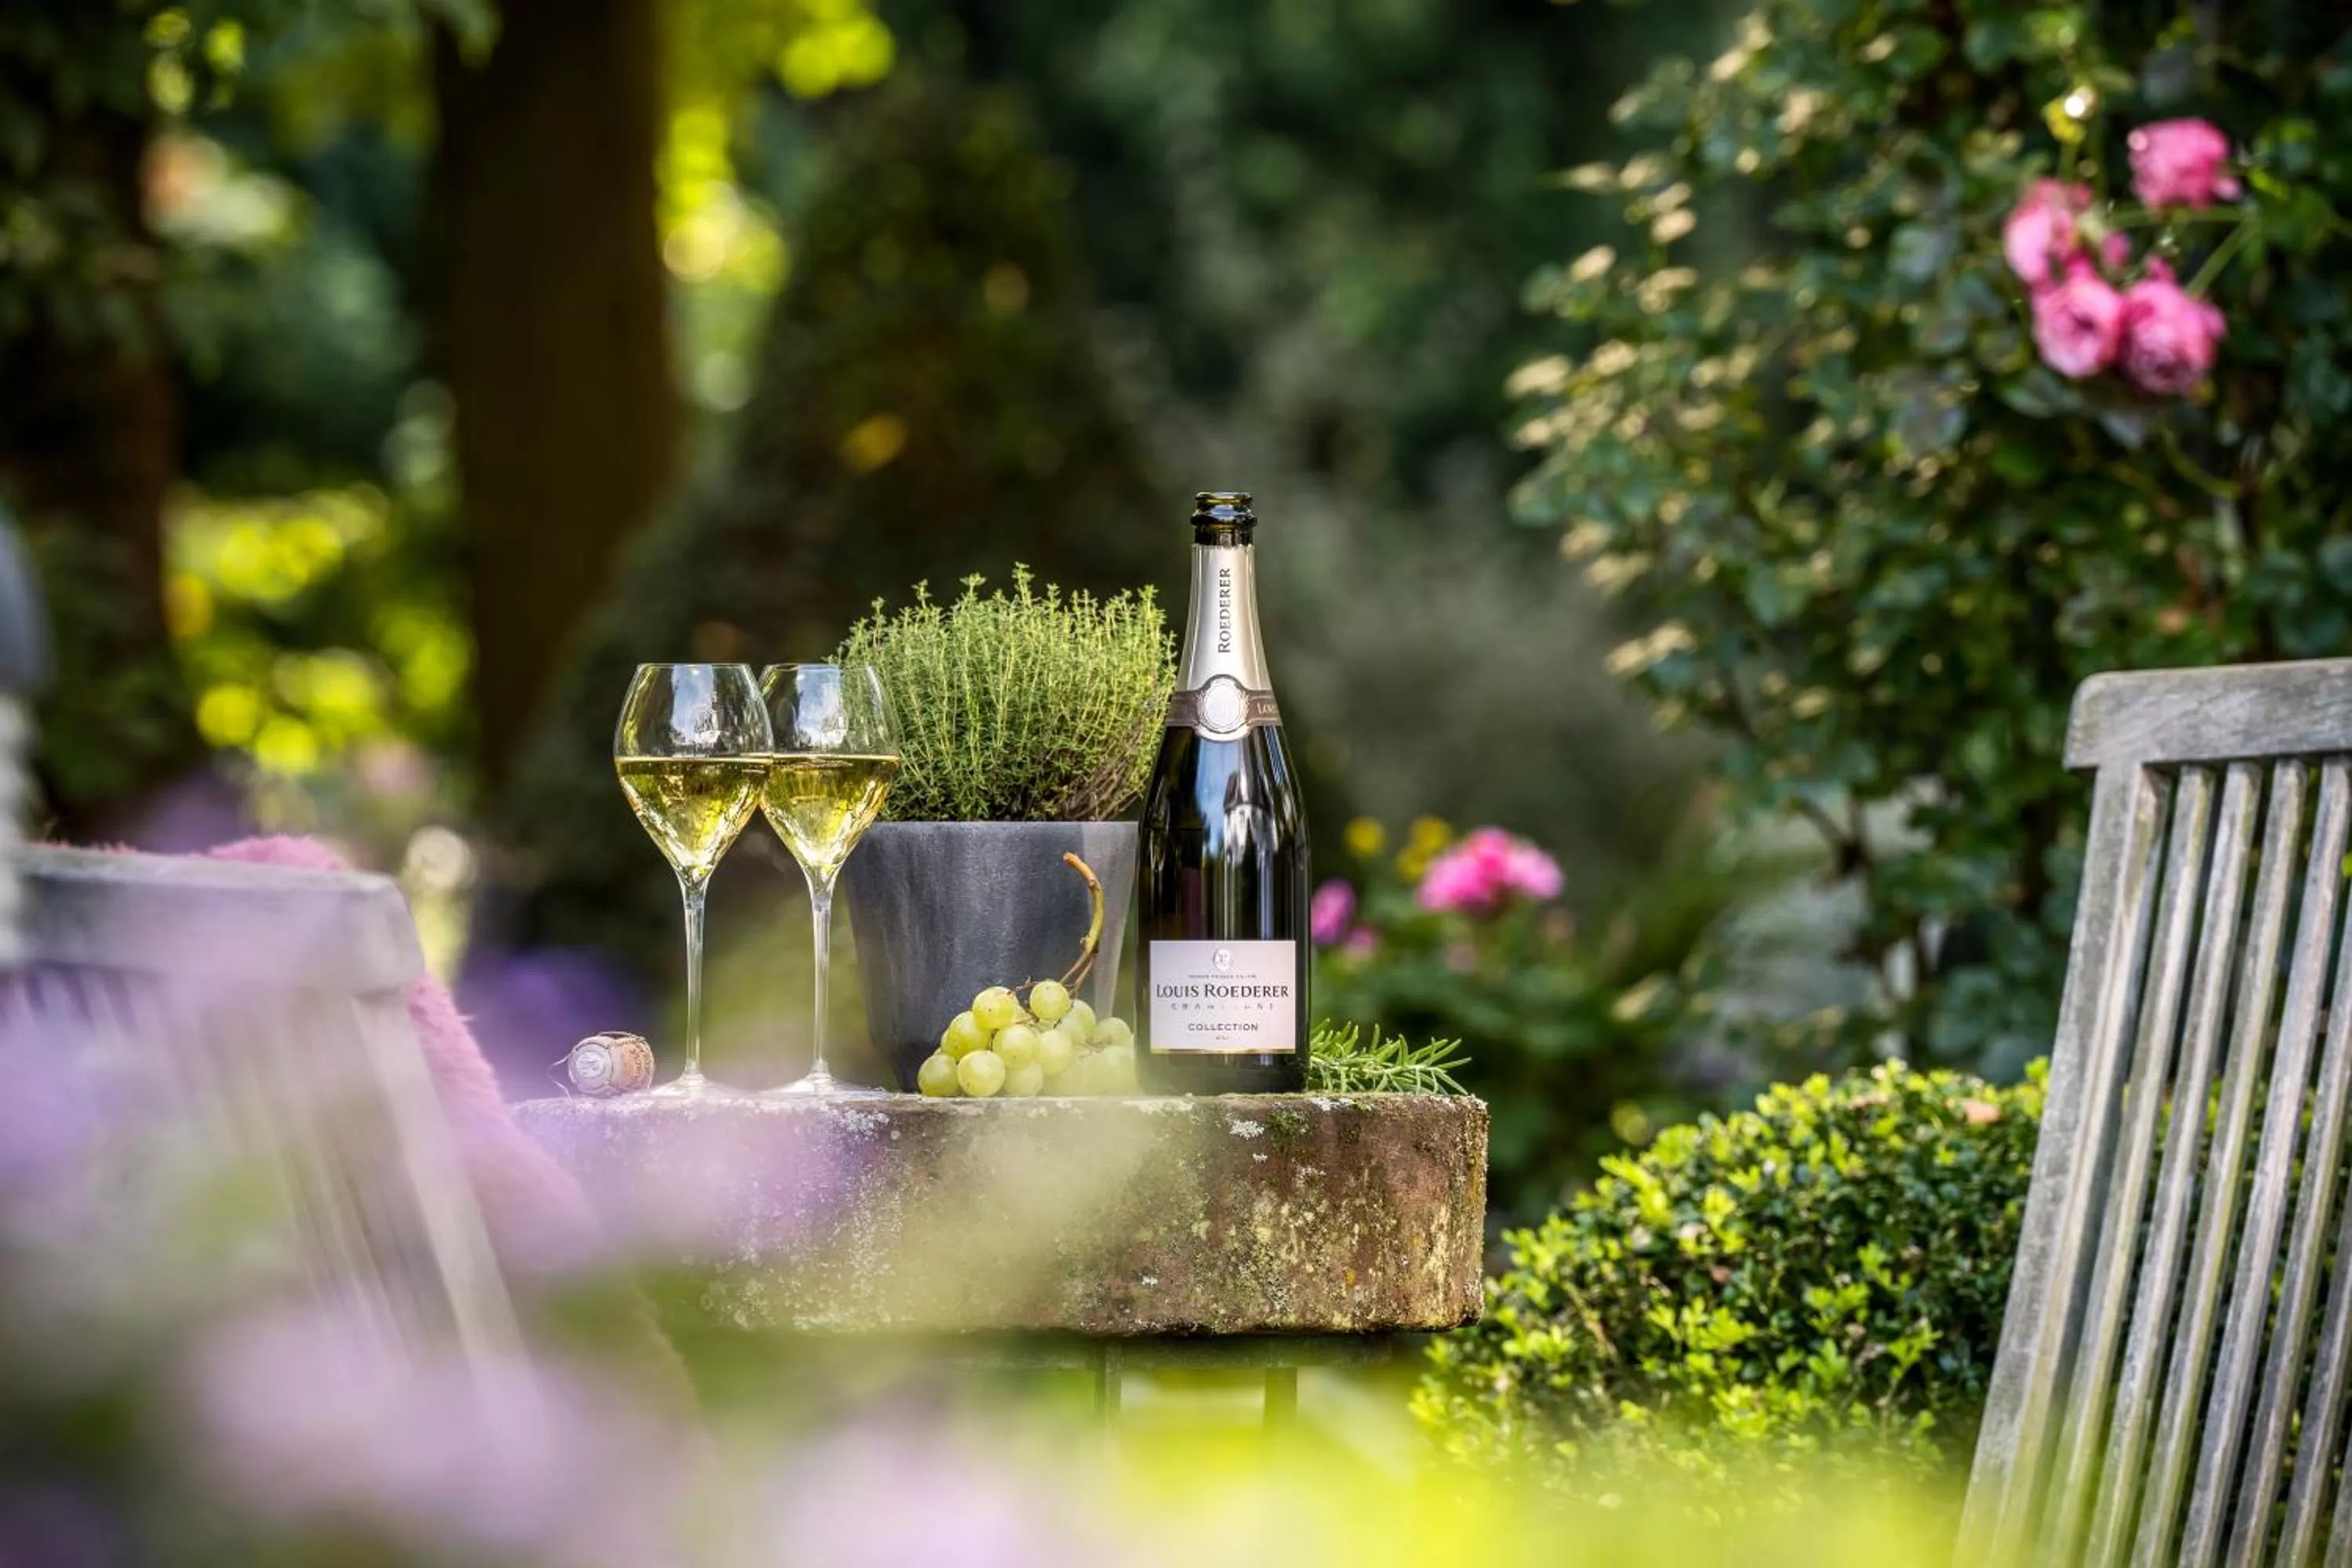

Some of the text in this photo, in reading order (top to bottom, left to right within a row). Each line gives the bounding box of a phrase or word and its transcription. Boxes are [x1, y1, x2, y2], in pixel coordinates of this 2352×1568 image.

[1218, 568, 1231, 653] ROEDERER
[1156, 983, 1288, 998] LOUIS ROEDERER
[1188, 1022, 1258, 1032] COLLECTION
